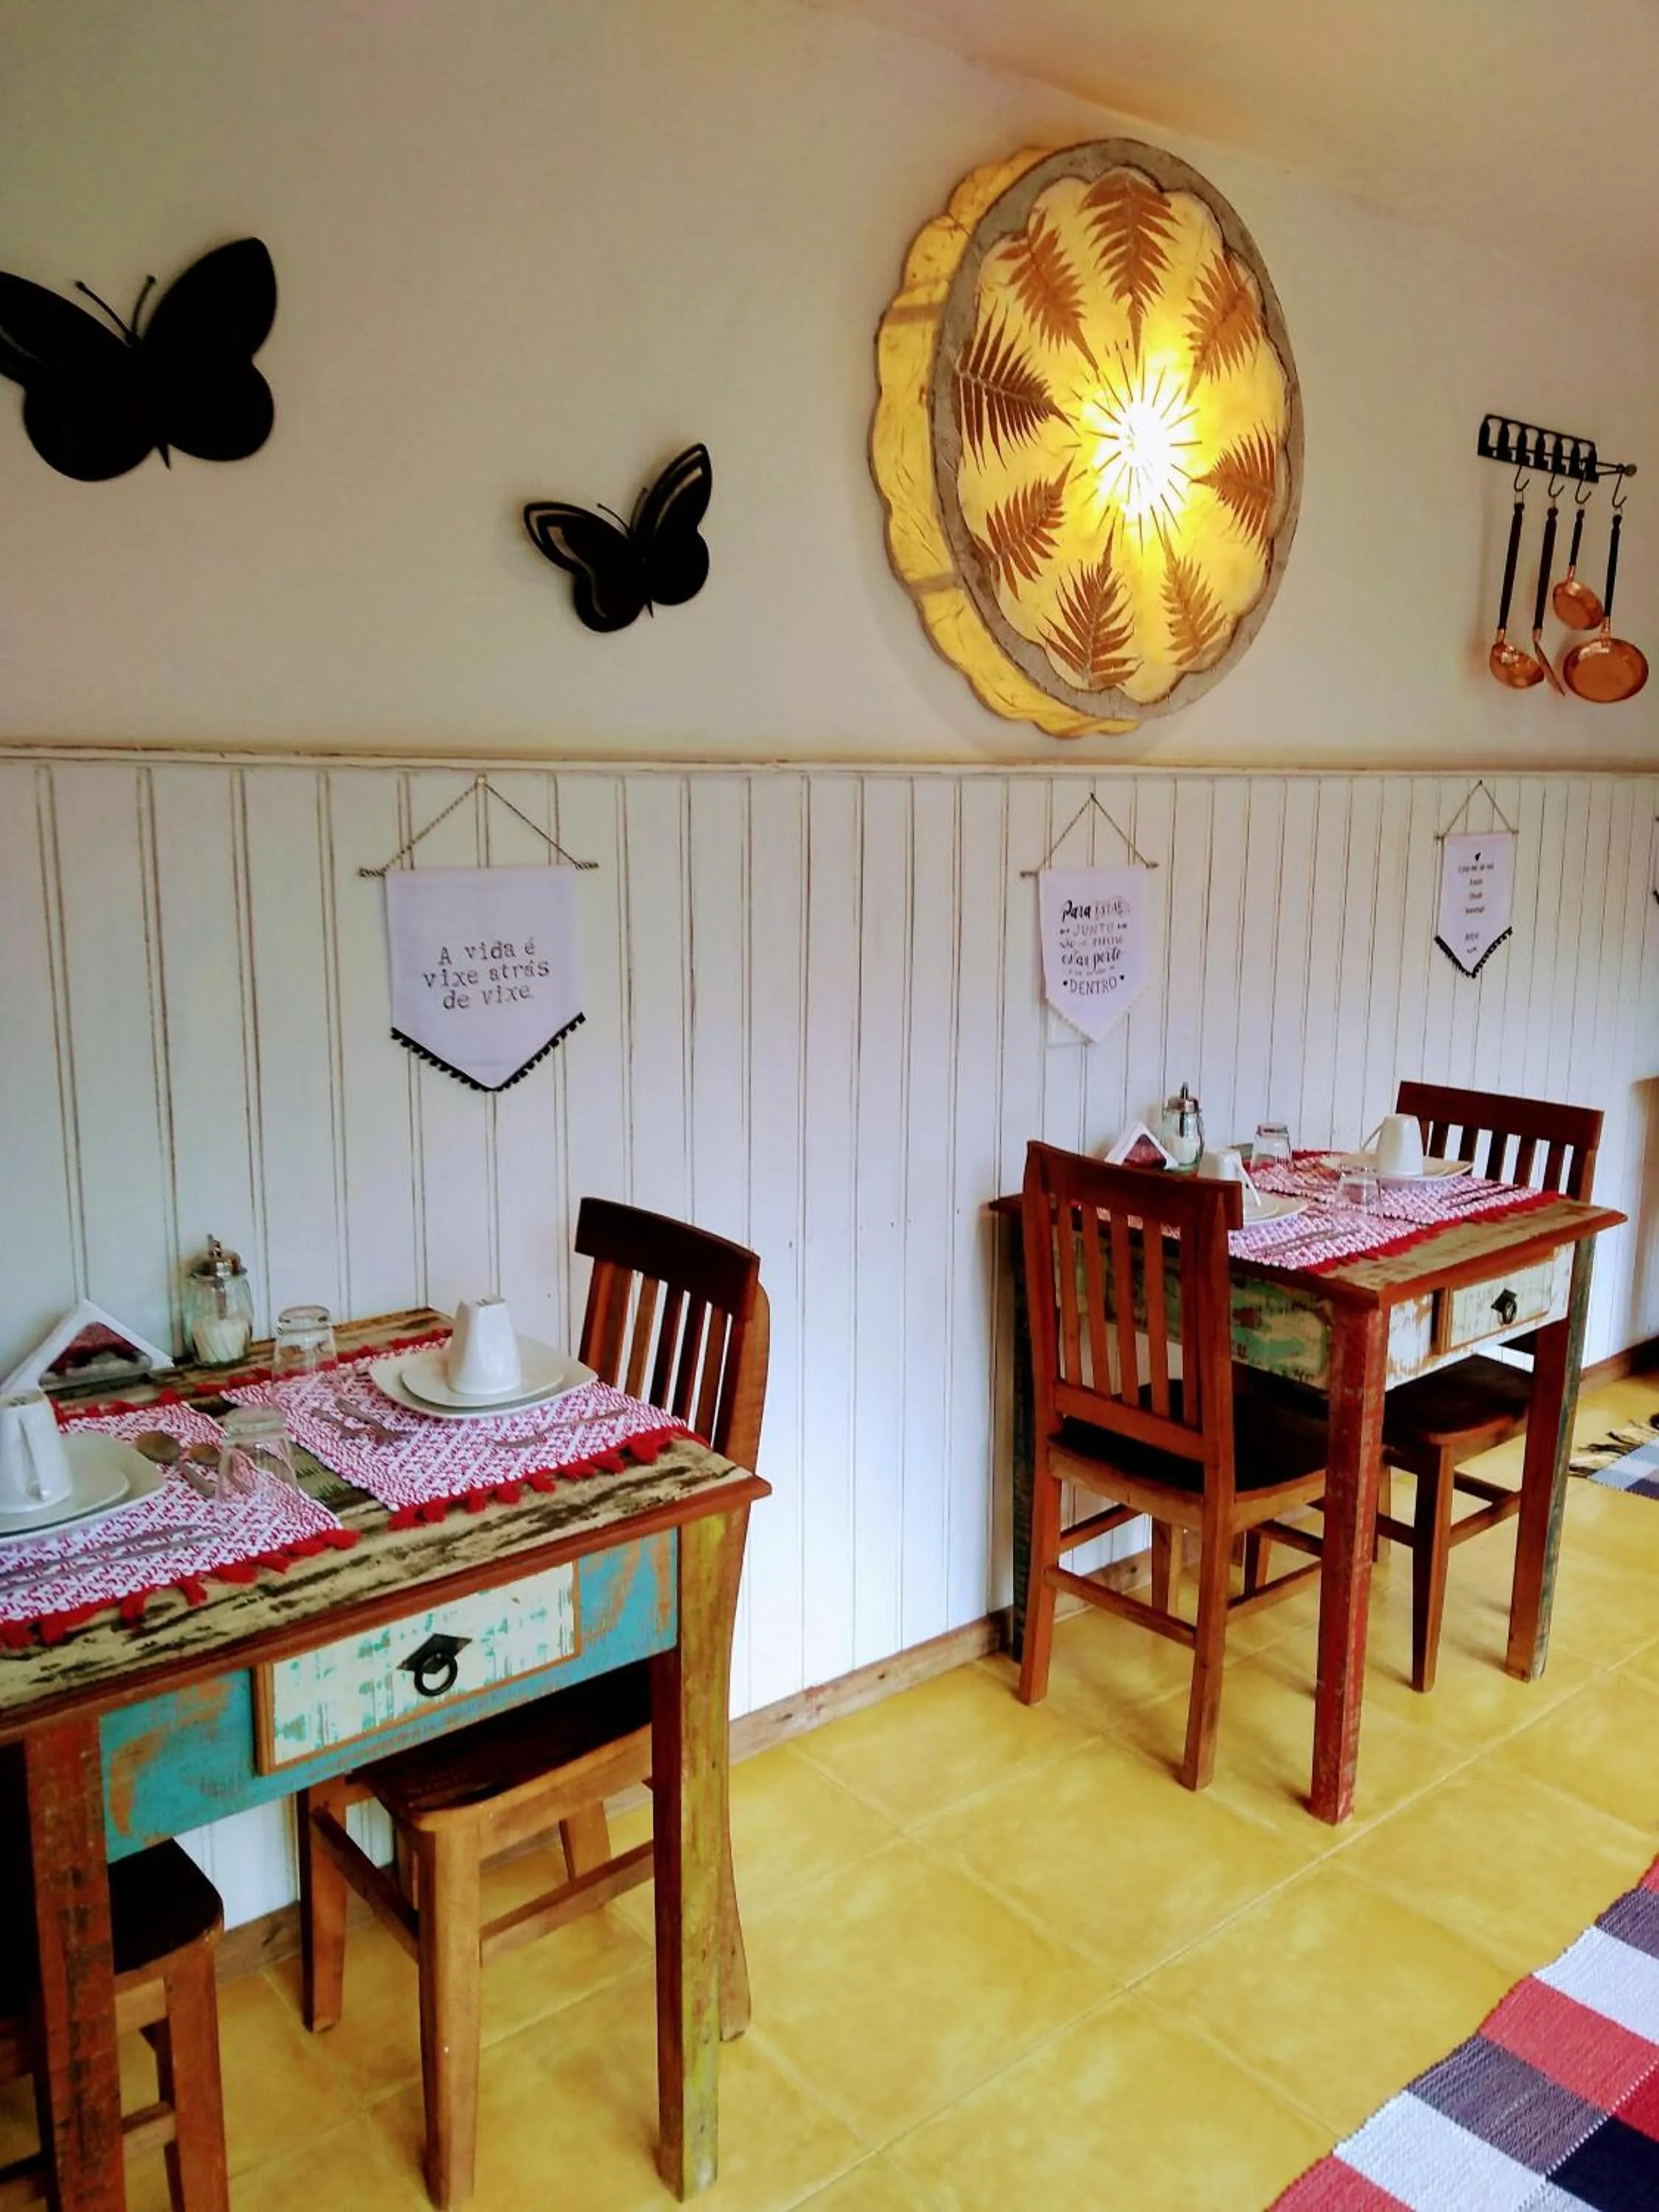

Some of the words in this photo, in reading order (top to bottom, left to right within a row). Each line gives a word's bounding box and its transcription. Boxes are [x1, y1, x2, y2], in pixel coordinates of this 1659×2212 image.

[438, 946, 452, 966] A
[464, 940, 516, 961] vida
[524, 936, 535, 956] é
[422, 968, 479, 989] vixe
[489, 959, 550, 981] atrás
[1069, 975, 1118, 995] DENTRO
[442, 989, 470, 1010] de
